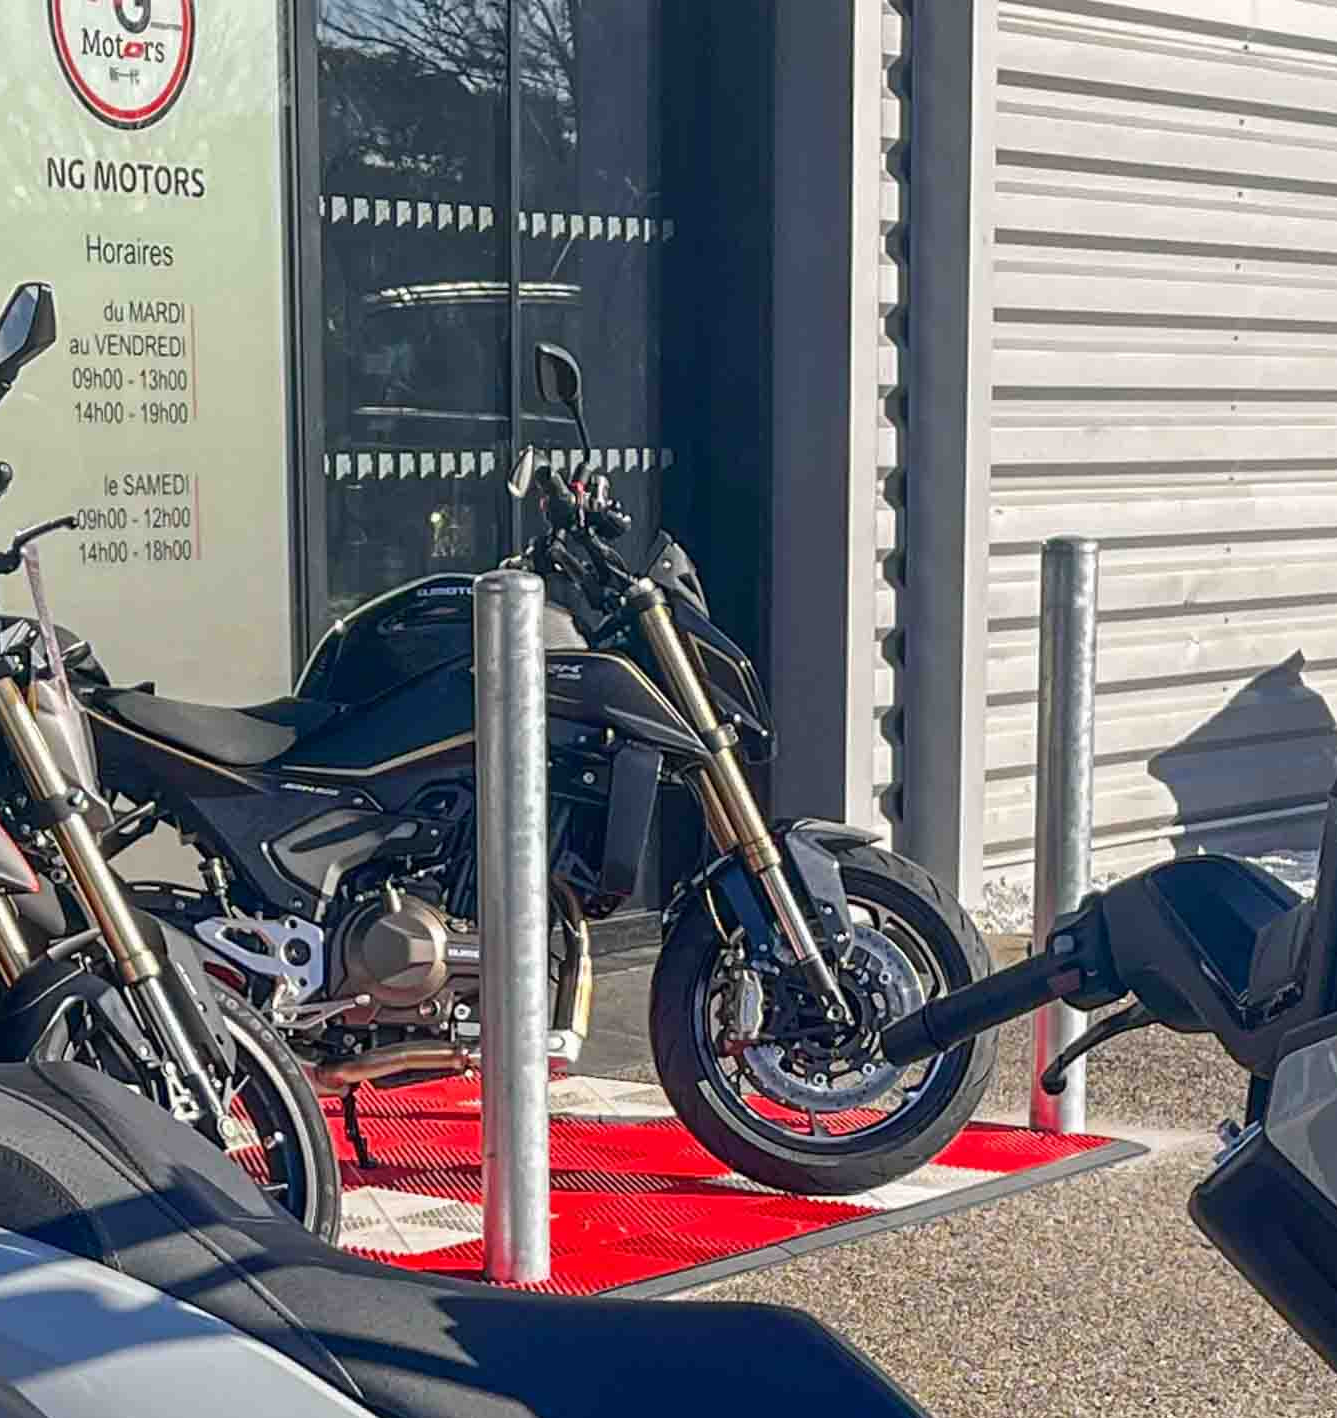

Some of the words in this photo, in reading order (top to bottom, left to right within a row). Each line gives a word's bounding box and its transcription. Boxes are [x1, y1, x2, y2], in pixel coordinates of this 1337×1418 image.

[47, 157, 85, 190] NG
[94, 160, 206, 198] MOTORS
[86, 233, 174, 266] Horaires
[103, 300, 124, 322] du
[129, 301, 185, 324] MARDI
[69, 337, 90, 355] au
[95, 334, 186, 358] VENDREDI
[72, 367, 124, 390] 09h00
[140, 368, 188, 391] 13h00
[74, 401, 124, 424] 14h00
[140, 402, 189, 424] 19h00
[103, 474, 119, 496] le
[123, 473, 189, 496] SAMEDI
[77, 507, 127, 530] 09h00
[144, 506, 191, 528] 12h00
[79, 540, 127, 564] 14h00
[145, 539, 192, 561] 18h00
